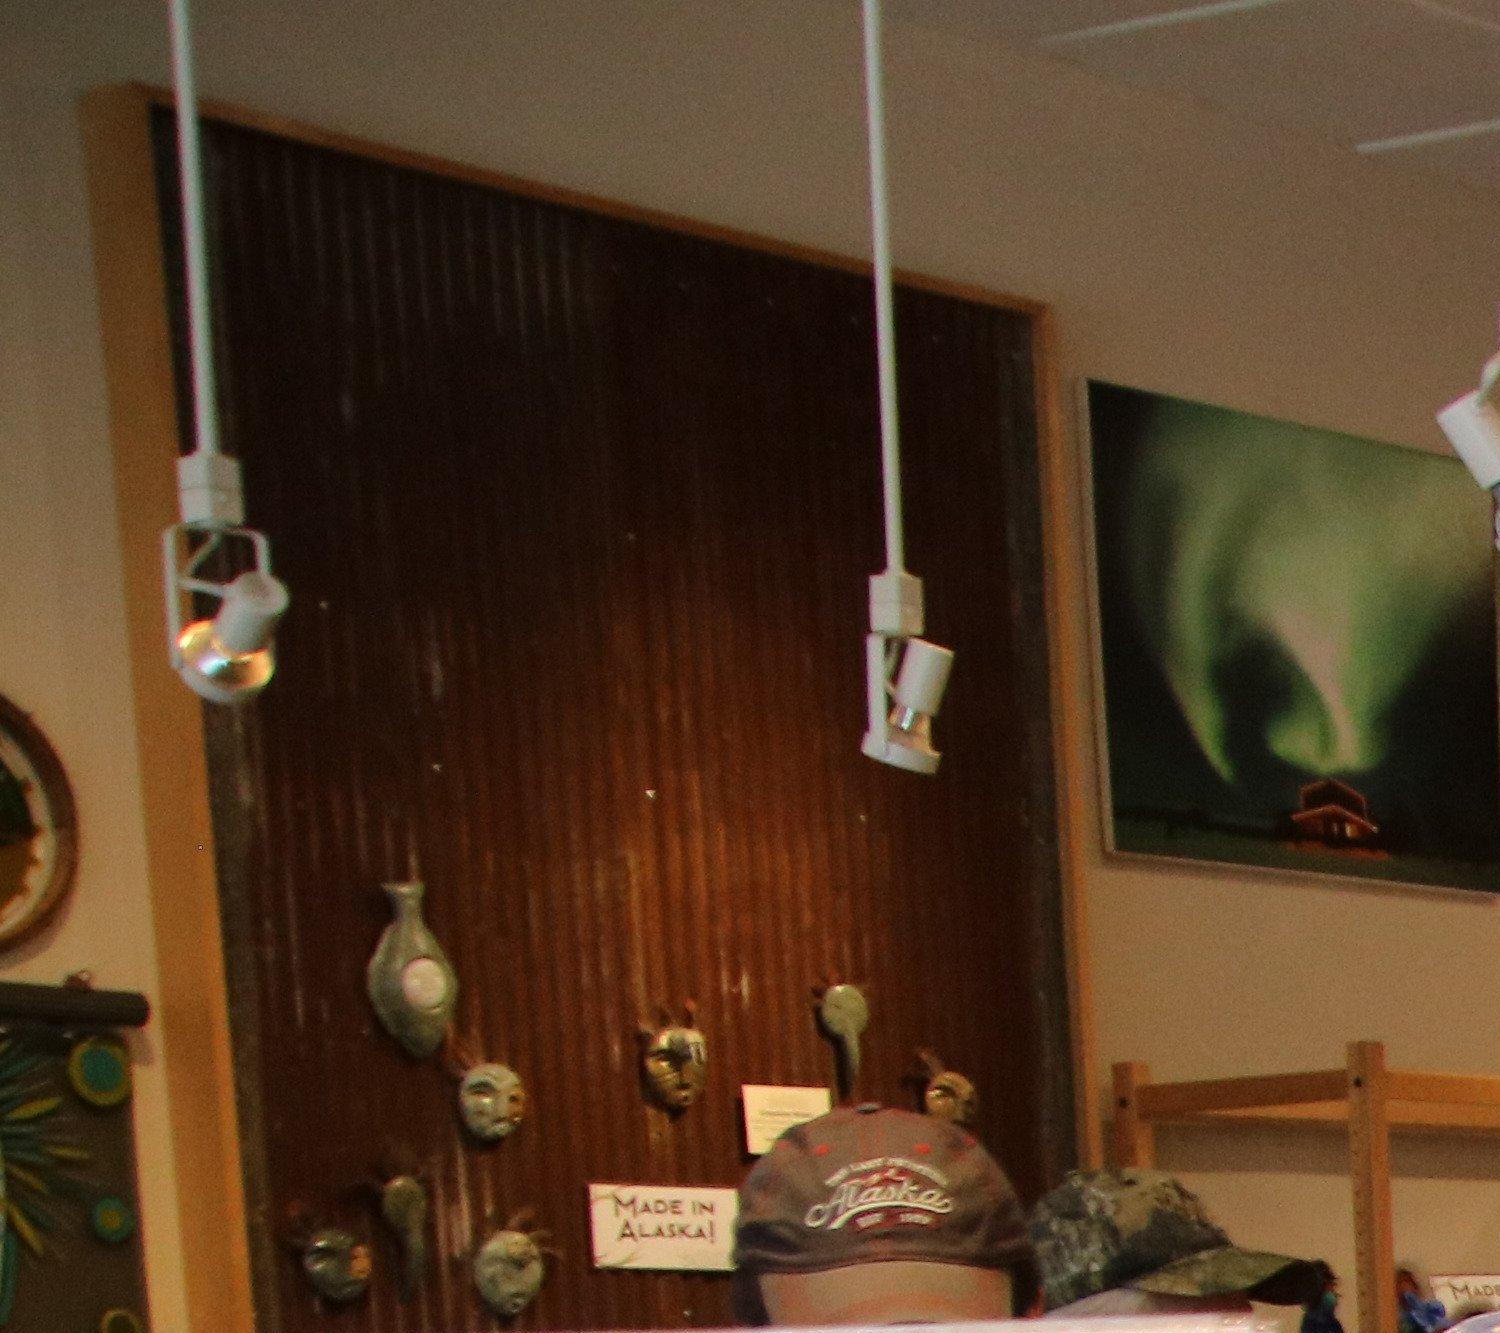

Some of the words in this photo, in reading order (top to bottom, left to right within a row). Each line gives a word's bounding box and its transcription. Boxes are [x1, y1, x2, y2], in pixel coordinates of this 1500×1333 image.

[613, 1193, 684, 1218] MADE
[690, 1200, 714, 1215] IN
[805, 1172, 953, 1230] Alaska
[617, 1218, 715, 1243] ALASKA!
